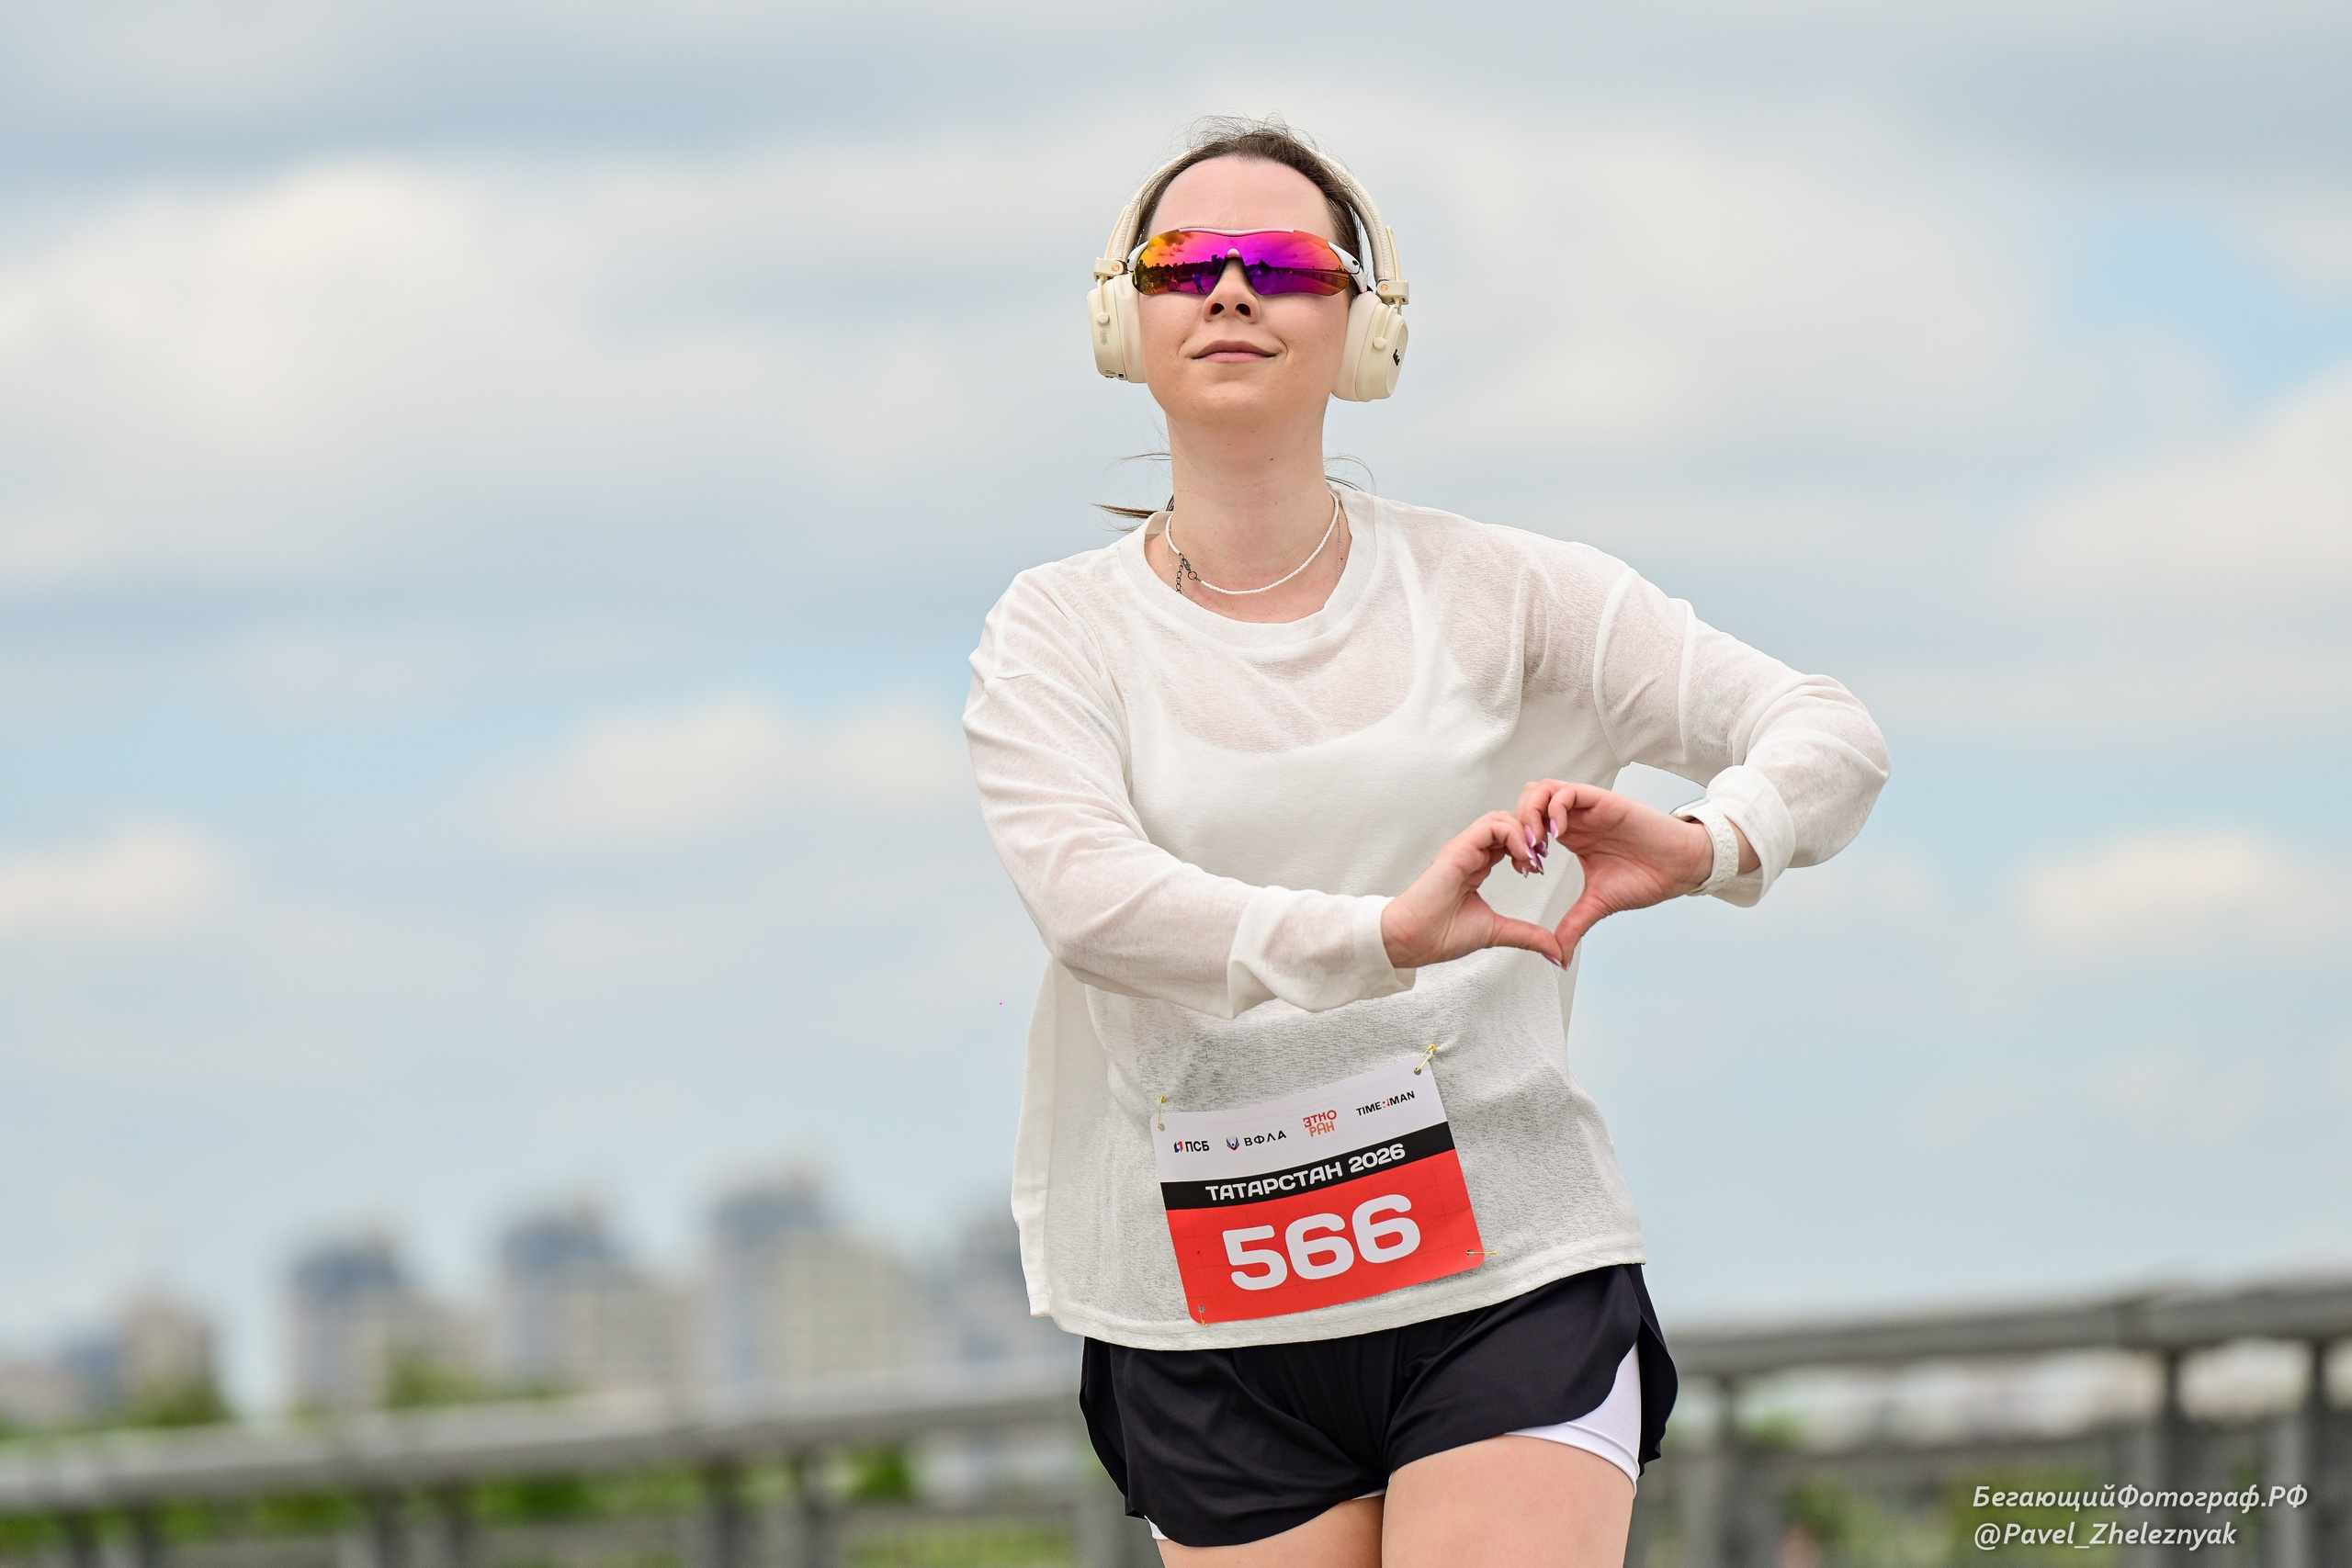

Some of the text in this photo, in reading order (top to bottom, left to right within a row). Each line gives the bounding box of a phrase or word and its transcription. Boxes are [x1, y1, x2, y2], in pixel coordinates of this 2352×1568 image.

[1303, 1110, 1338, 1128] ЭТНО
[1309, 1121, 1335, 1137] РАН
[1185, 1140, 1210, 1153] ПСБ
[1244, 1130, 1287, 1146] ВФЛА
[1205, 1143, 1407, 1201] ТАТАРСТАН 2026
[1222, 1193, 1421, 1291] 566
